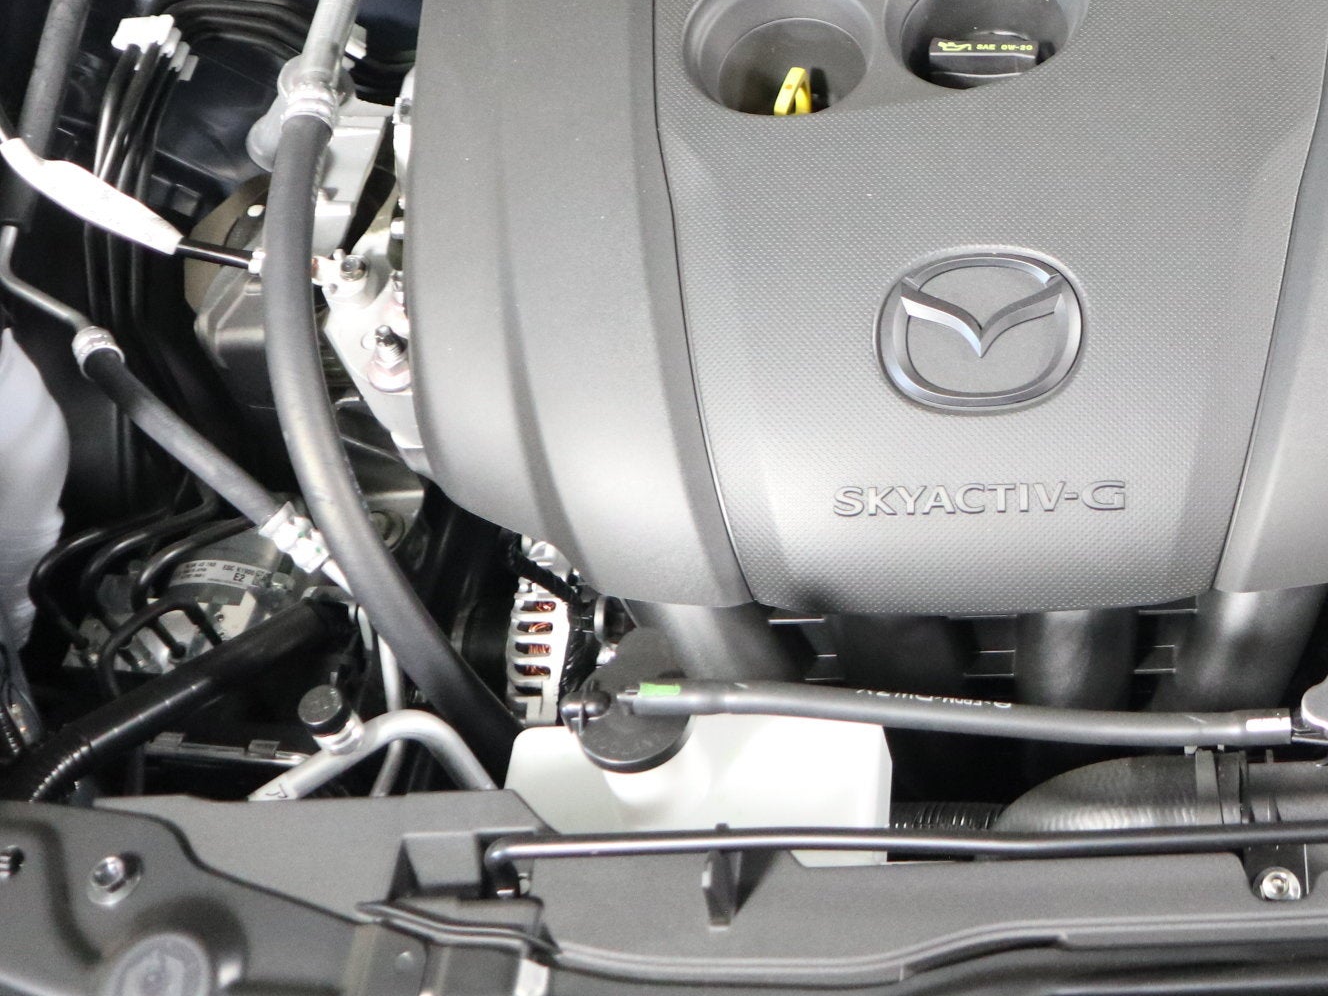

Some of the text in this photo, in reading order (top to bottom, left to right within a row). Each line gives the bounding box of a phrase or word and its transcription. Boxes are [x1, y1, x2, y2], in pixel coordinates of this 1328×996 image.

[975, 43, 1034, 52] SAE 0W-20
[832, 479, 1126, 517] SKYACTIV-G
